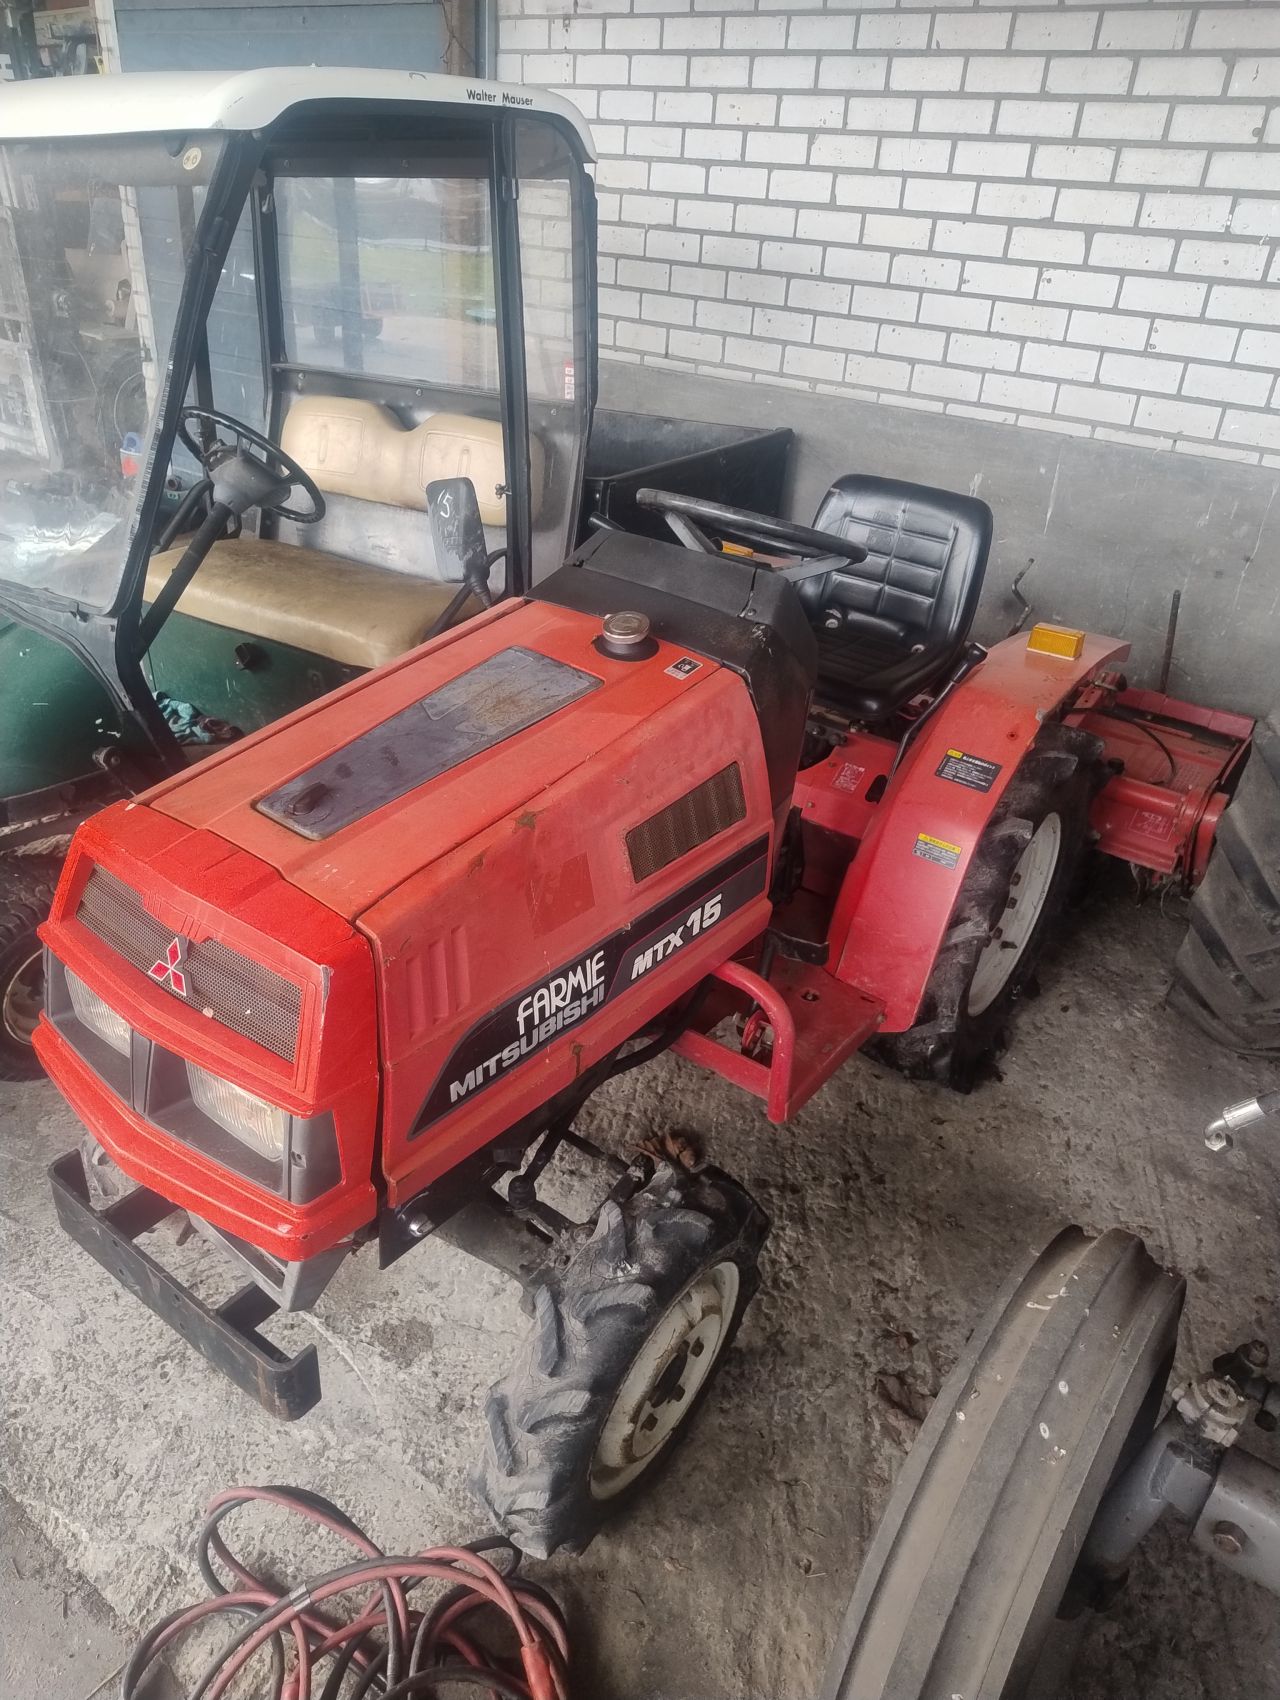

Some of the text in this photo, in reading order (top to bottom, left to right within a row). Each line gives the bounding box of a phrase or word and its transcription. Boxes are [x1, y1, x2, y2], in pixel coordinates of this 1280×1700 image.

[466, 88, 534, 106] Walter Mauser
[517, 950, 604, 1035] FARMIE
[450, 983, 604, 1103] MITSUBISHI
